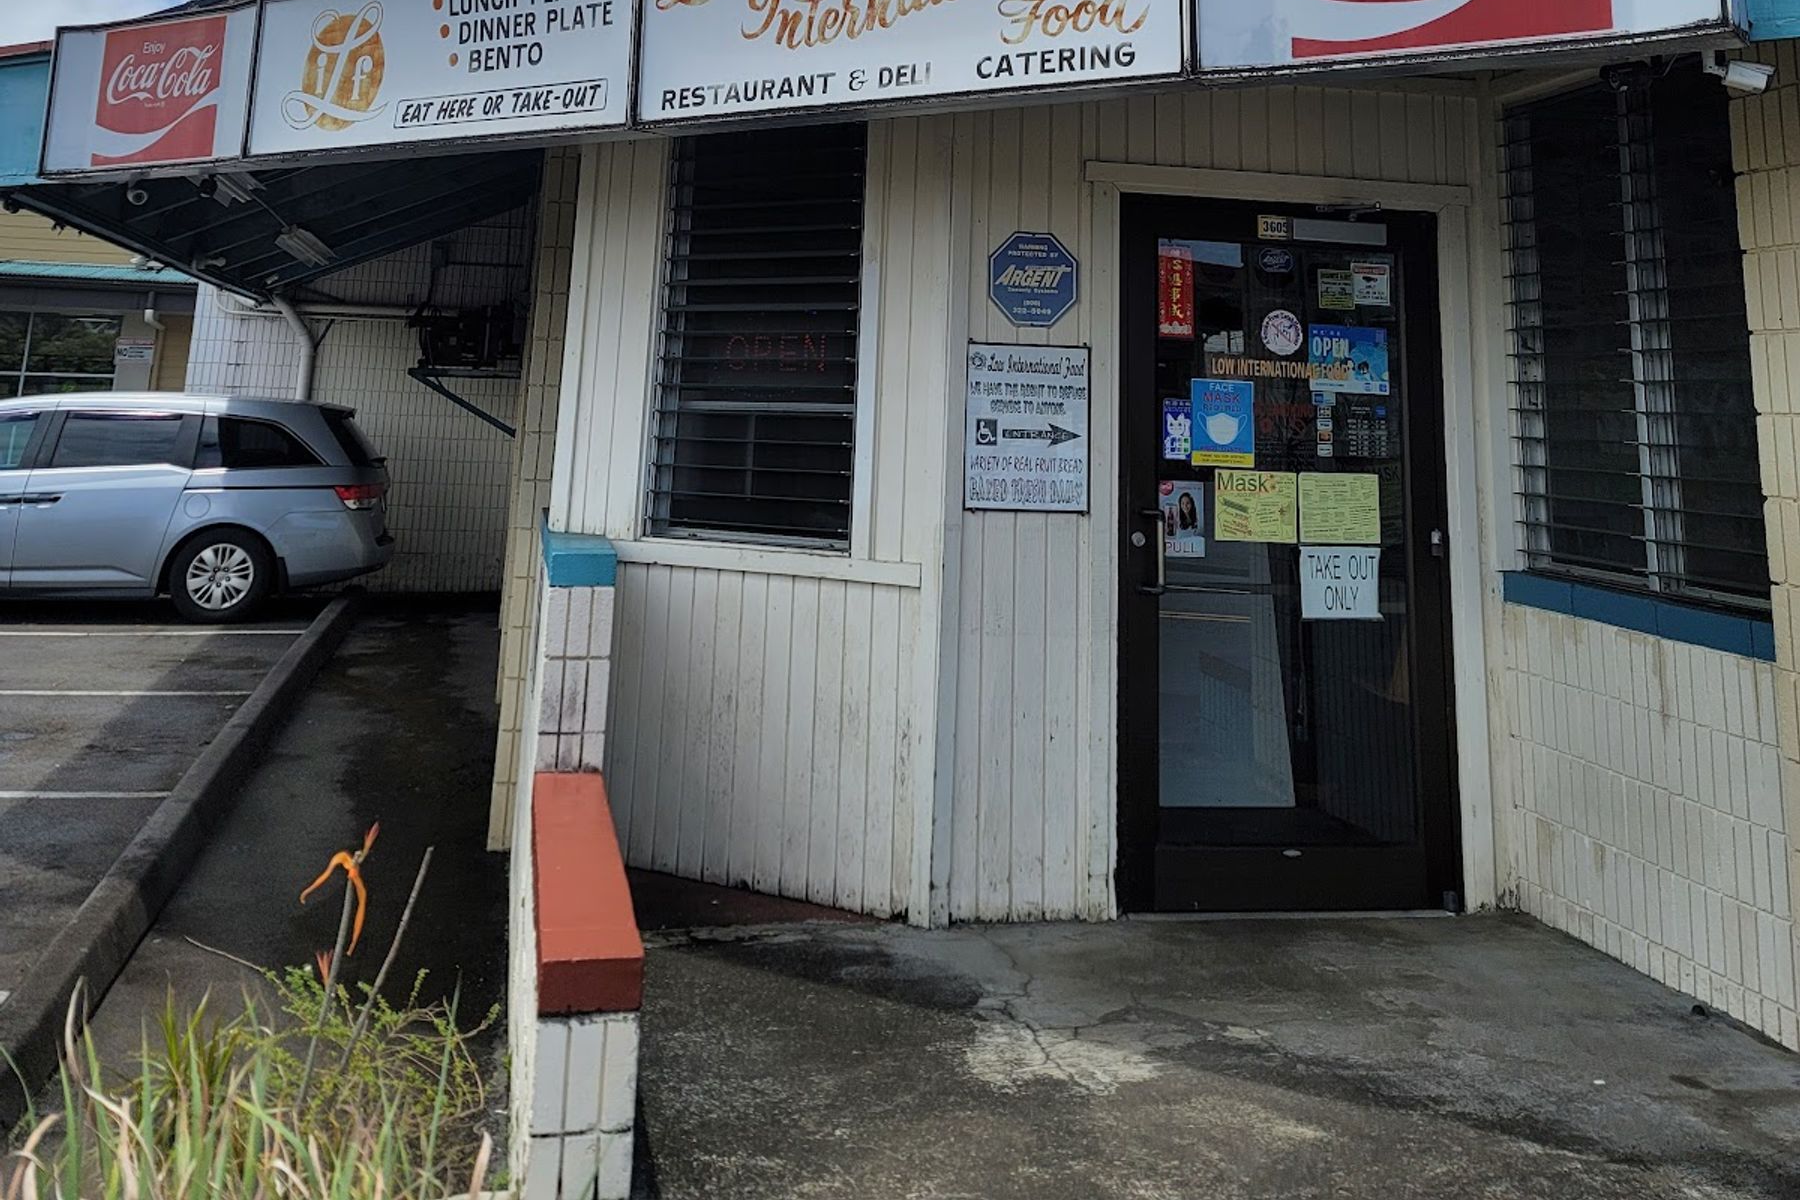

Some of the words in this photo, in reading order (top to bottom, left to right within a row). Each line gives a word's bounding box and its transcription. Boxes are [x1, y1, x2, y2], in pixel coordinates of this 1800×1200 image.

[459, 12, 536, 44] DINNER
[546, 1, 613, 33] PLATE
[142, 41, 166, 55] Enjoy
[468, 42, 543, 73] BENTO
[107, 43, 219, 104] Coca-Cola
[661, 71, 837, 111] RESTAURANT
[848, 67, 868, 92] &
[879, 62, 932, 88] DELI
[976, 42, 1136, 81] CATERING
[401, 102, 434, 123] EAT
[436, 98, 477, 120] HERE
[483, 94, 502, 115] OR
[512, 84, 601, 113] TAKE-OUT
[1263, 220, 1288, 234] 3605
[995, 264, 1072, 288] ARGENT
[726, 335, 827, 372] OPEN
[1313, 337, 1350, 358] OPEN
[1212, 357, 1234, 375] LOW
[1237, 359, 1320, 379] INTERNATIONAL
[1203, 392, 1240, 403] MASK
[1209, 382, 1235, 392] FACE
[1005, 431, 1069, 440] ENTRANCE
[1002, 456, 1012, 471] OF
[1014, 456, 1033, 472] REAL
[1035, 457, 1056, 473] FRUIT
[1217, 472, 1269, 493] Mask
[1165, 541, 1196, 554] PULL
[1308, 555, 1341, 580] TAKE
[1349, 555, 1376, 580] OUT
[1324, 586, 1359, 611] ONLY
